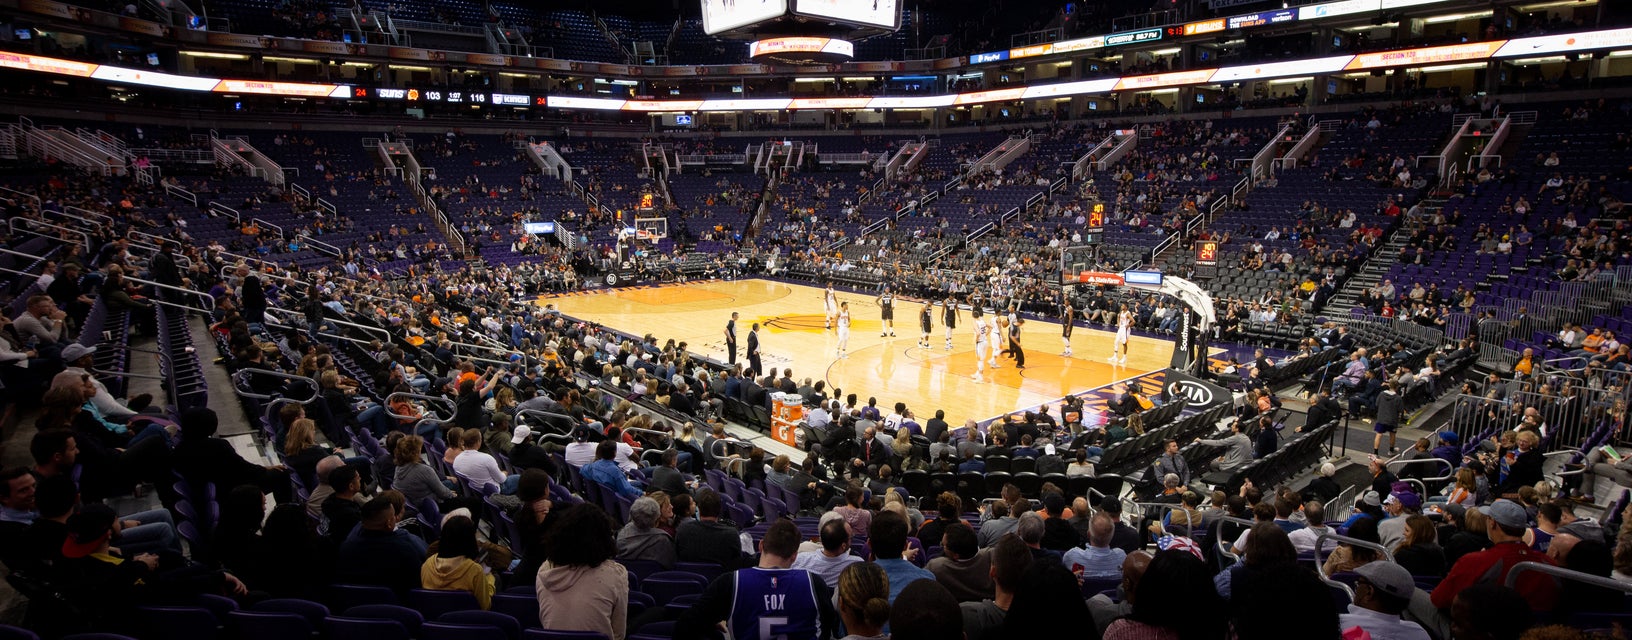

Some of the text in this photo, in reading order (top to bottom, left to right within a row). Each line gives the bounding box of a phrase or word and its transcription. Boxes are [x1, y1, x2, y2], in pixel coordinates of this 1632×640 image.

[1230, 15, 1259, 23] DOWNLOAD
[984, 53, 1000, 61] PayPal
[355, 89, 367, 97] 24
[425, 91, 441, 100] 103
[503, 96, 528, 104] KINGS
[537, 97, 546, 105] 24
[1090, 212, 1103, 226] 24
[1202, 250, 1213, 259] 24
[1180, 312, 1190, 351] Southwest
[779, 425, 789, 441] G
[764, 594, 786, 611] FOX
